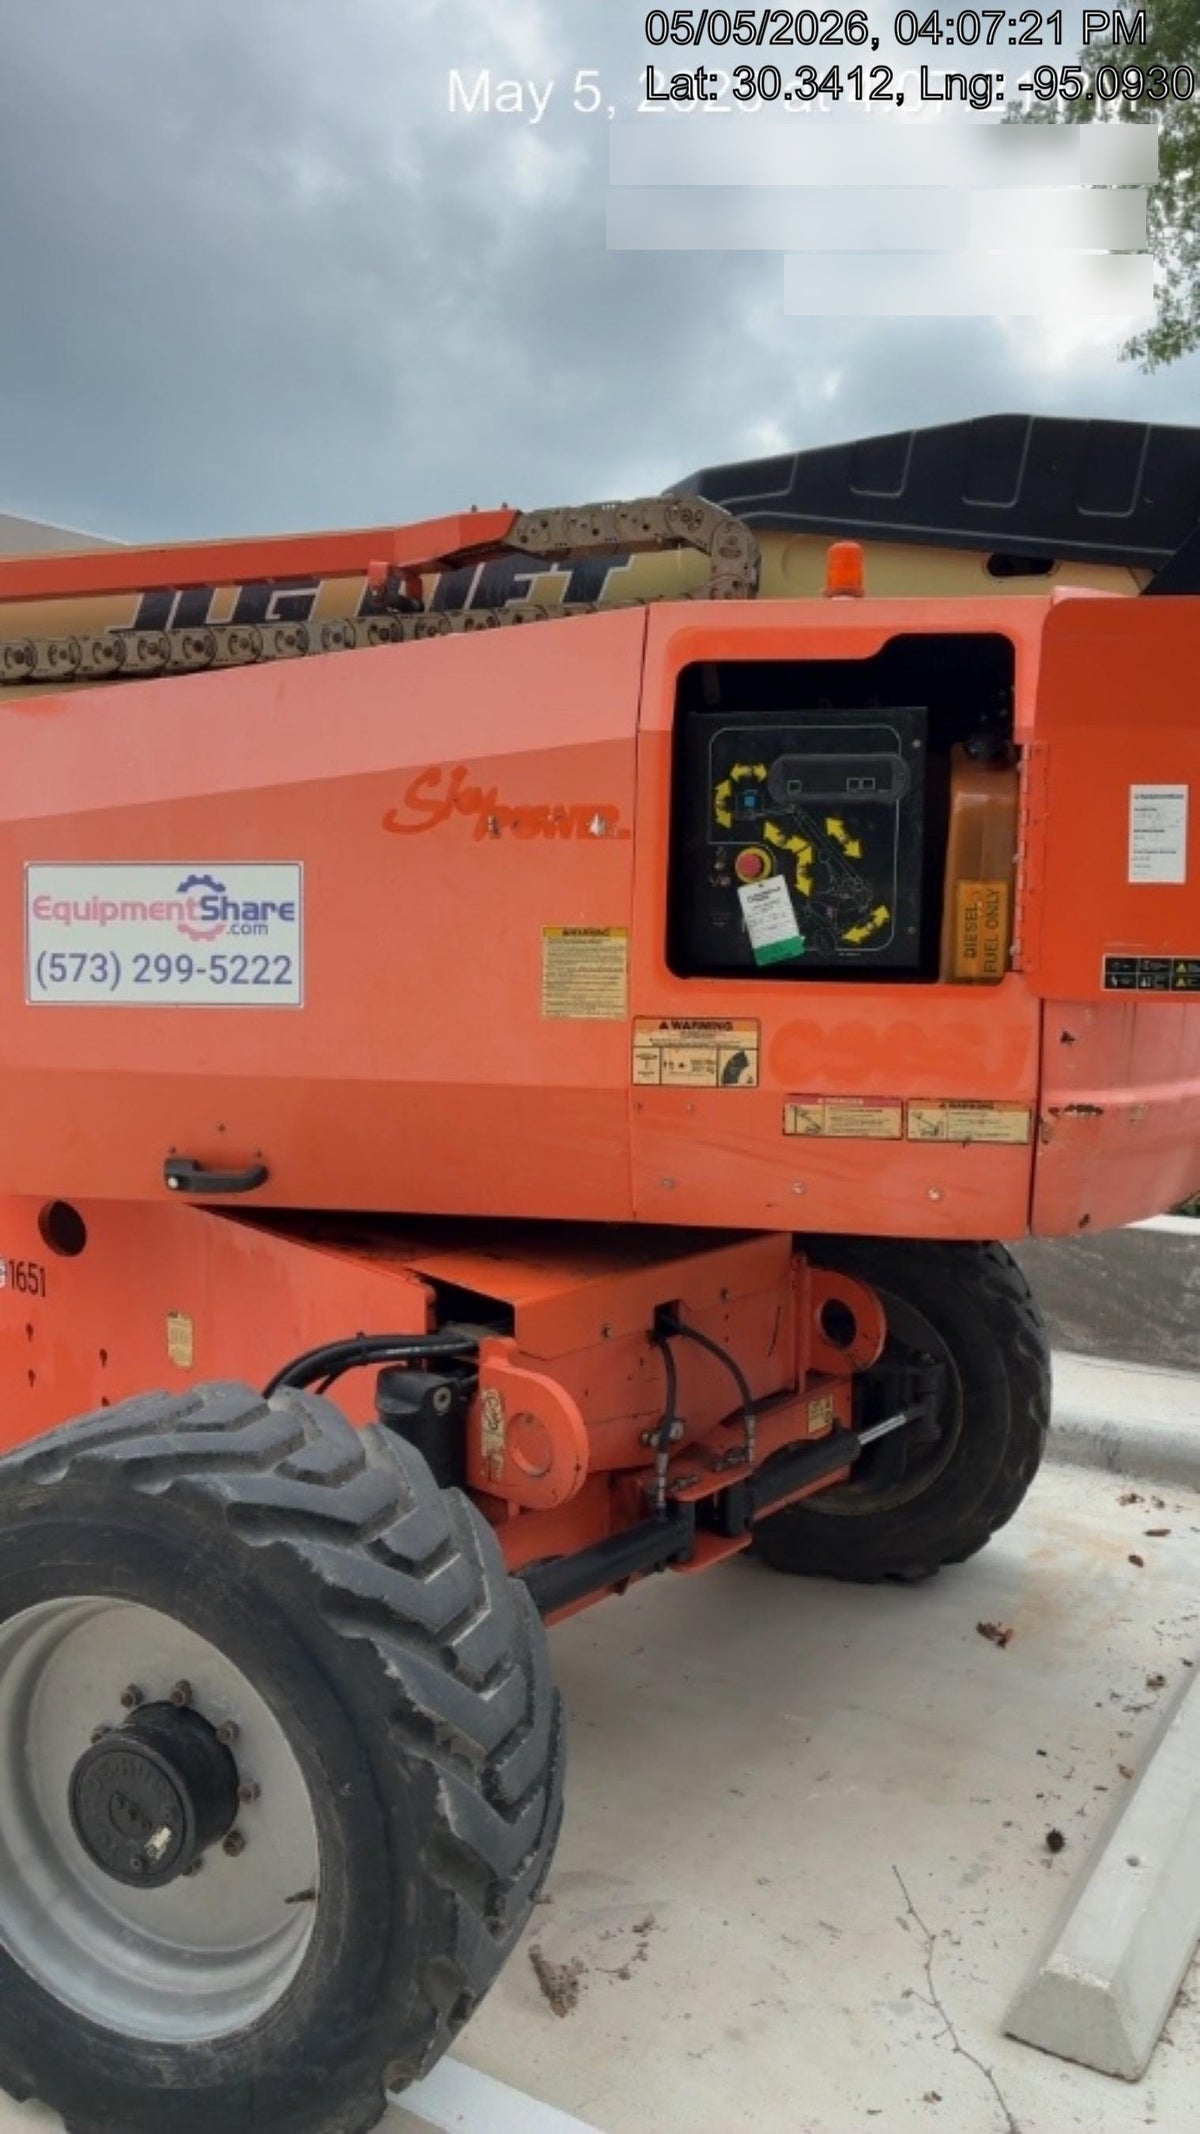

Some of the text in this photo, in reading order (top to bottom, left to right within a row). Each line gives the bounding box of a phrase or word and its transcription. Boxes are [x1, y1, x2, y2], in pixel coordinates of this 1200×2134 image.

[32, 895, 296, 927] EquipmentShare
[226, 923, 269, 936] .com
[963, 902, 979, 959] DIESEL
[984, 888, 1000, 973] FUEL ONLY
[36, 951, 293, 991] (573) 299-5222
[671, 1020, 734, 1031] WARNING
[9, 1259, 46, 1298] 1651
